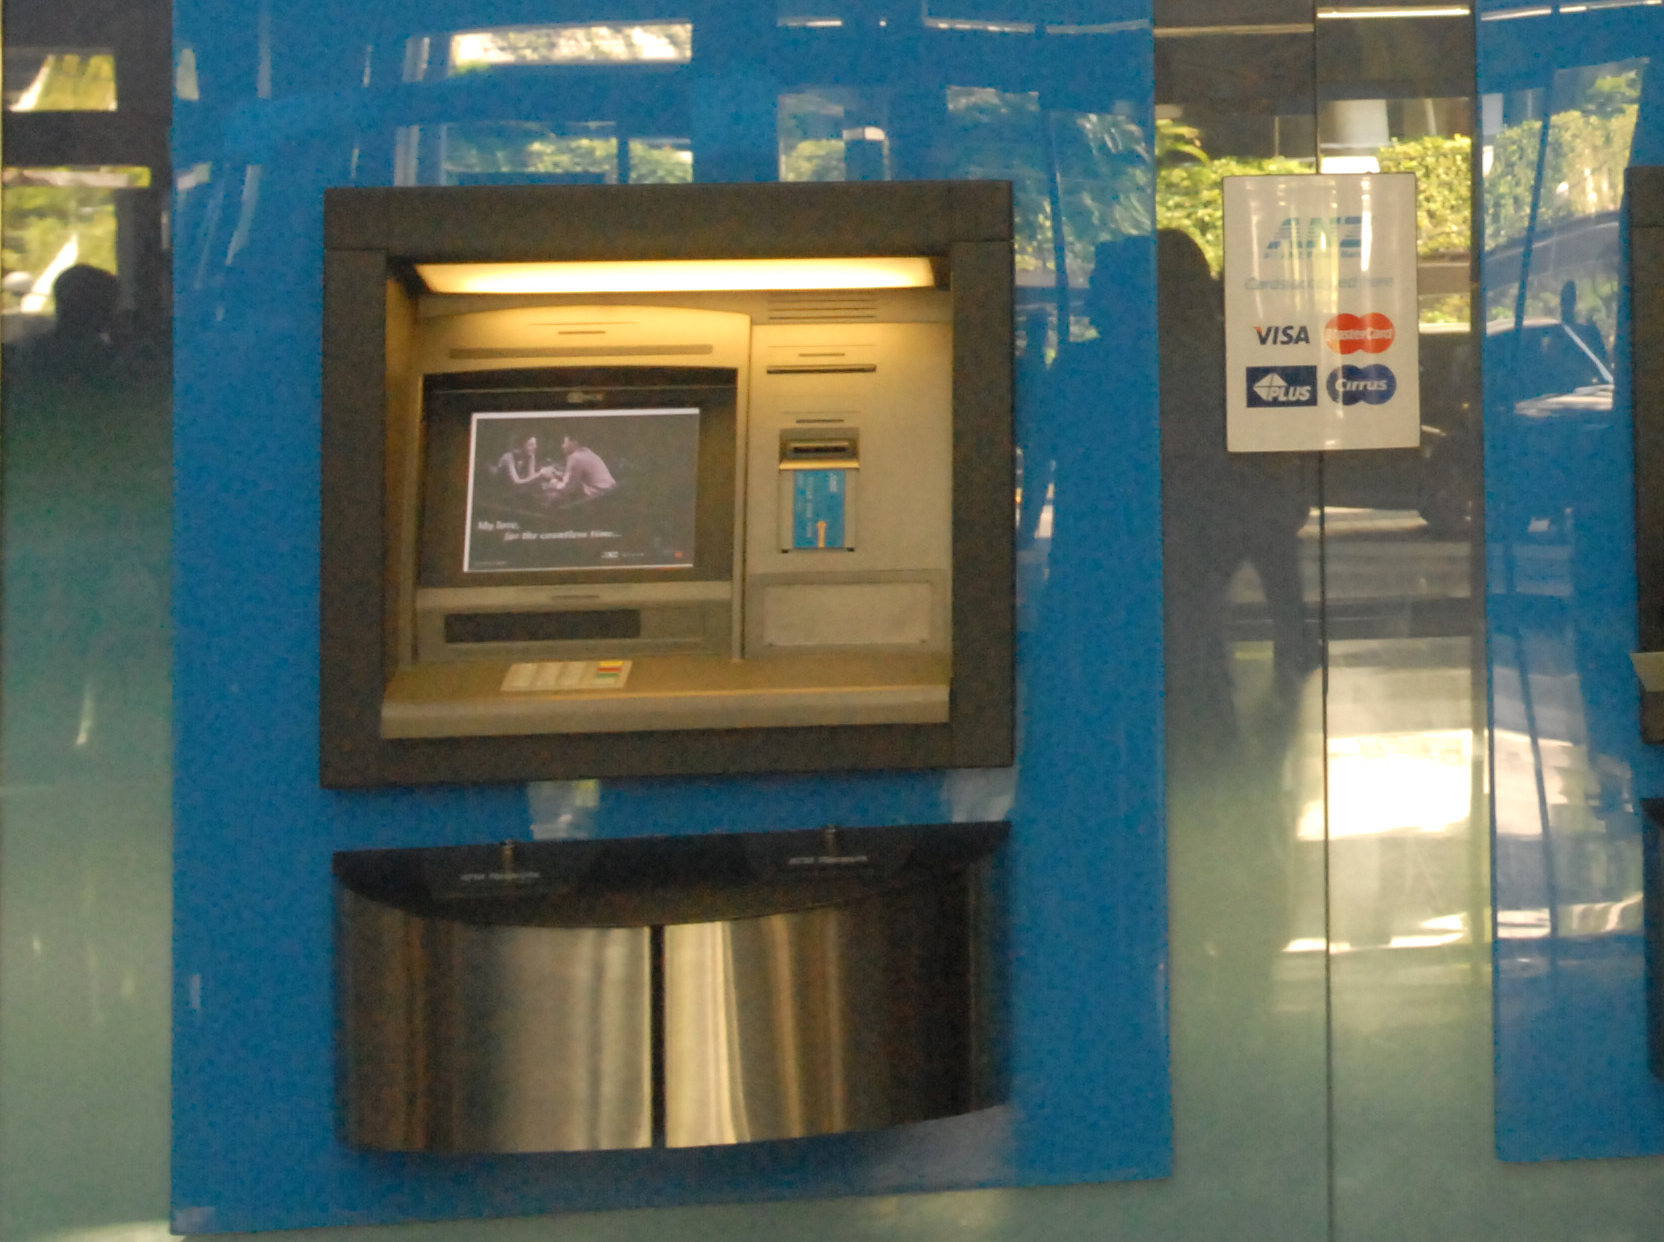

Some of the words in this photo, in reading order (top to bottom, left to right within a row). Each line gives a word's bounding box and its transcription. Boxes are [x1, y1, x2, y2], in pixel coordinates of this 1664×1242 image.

[1254, 325, 1310, 345] VISA
[1266, 385, 1312, 402] PLUS
[1335, 378, 1388, 392] Cirrus
